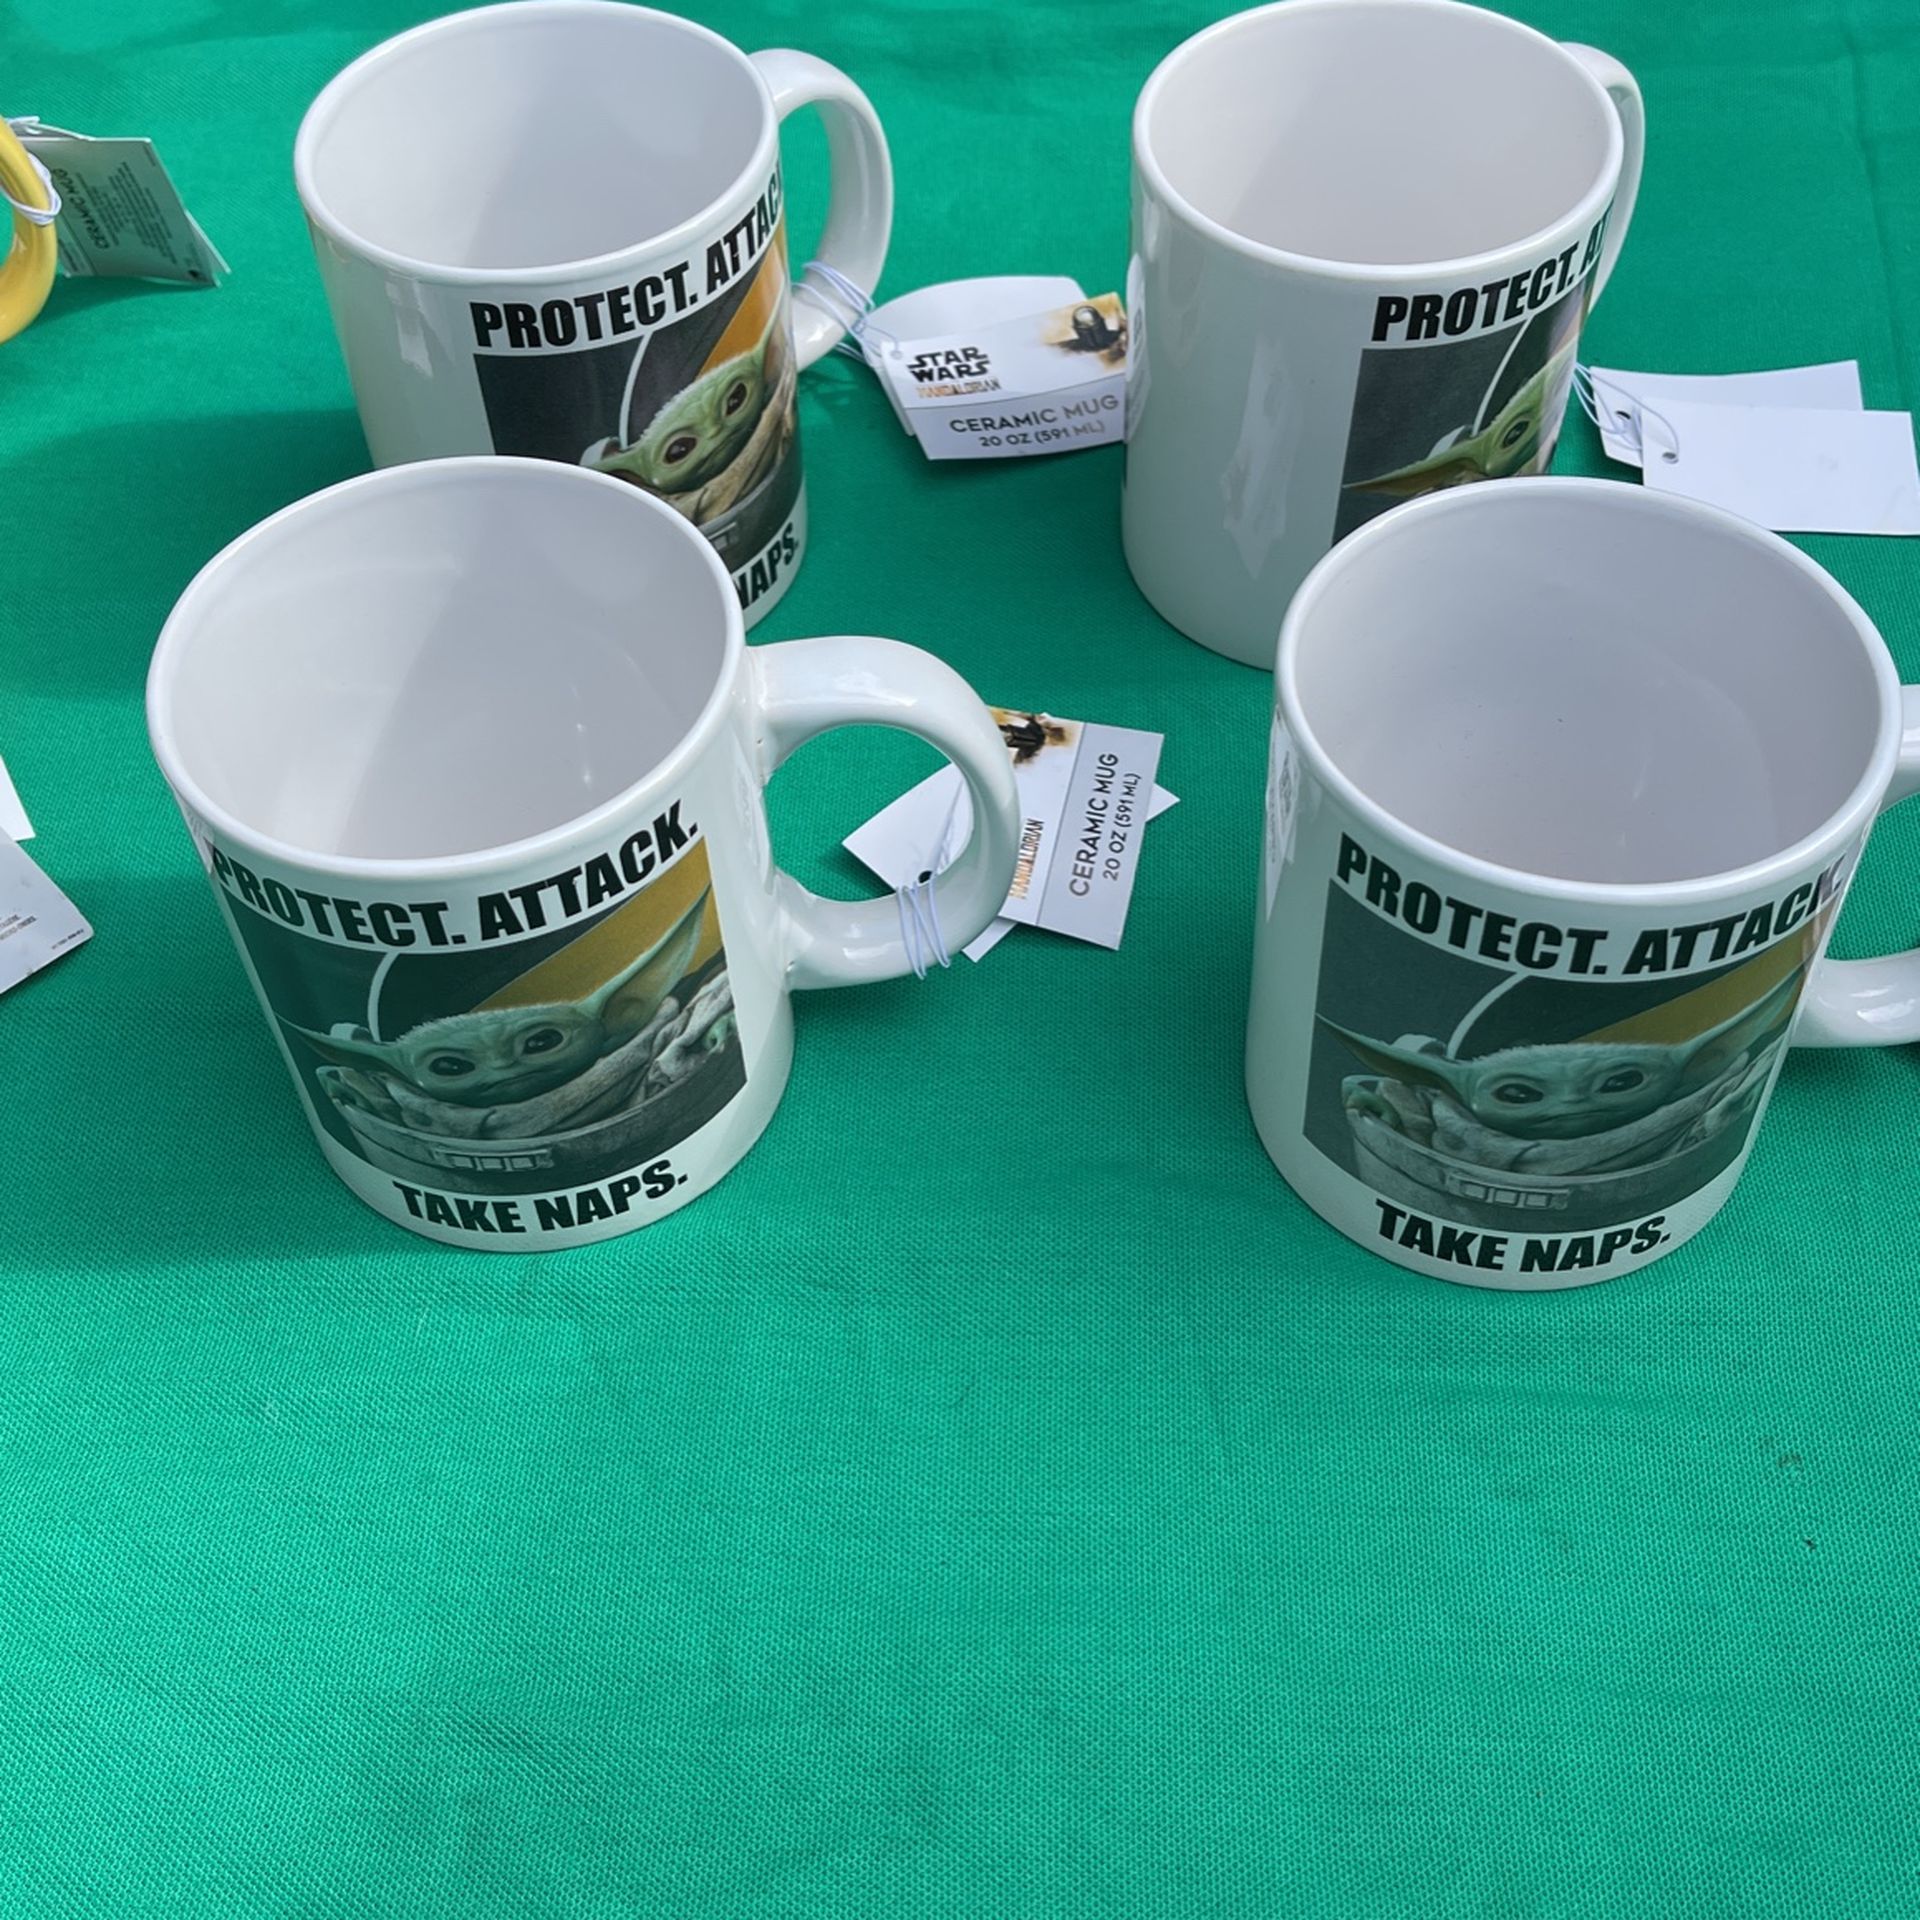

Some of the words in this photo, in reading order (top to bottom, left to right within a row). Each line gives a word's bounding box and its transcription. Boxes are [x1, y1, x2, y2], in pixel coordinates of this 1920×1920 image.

[469, 260, 699, 348] PROTECT.
[706, 160, 783, 296] ATTAC
[1371, 240, 1579, 342] PROTECT.
[907, 346, 988, 369] STAR
[910, 361, 990, 383] WARS
[950, 408, 1057, 433] CERAMIC
[1064, 395, 1119, 420] MUG
[979, 436, 1000, 447] 20
[1006, 433, 1031, 445] OZ
[1036, 428, 1069, 444] (591
[1074, 420, 1105, 436] ML)
[1122, 773, 1142, 800] ML)
[1069, 798, 1108, 897] CERAMIC
[1093, 753, 1119, 794] MUG
[1114, 798, 1134, 828] (591
[1109, 831, 1127, 854] OZ
[204, 836, 466, 947] PROTECT.
[478, 798, 698, 942] ATTACK.
[1103, 858, 1121, 881] 20
[1336, 832, 1608, 975] PROTECT.
[392, 1181, 527, 1233] TAKE
[534, 1159, 688, 1232] NAPS.
[1376, 1198, 1508, 1271] TAKE
[1519, 1216, 1671, 1273] NAPS.
